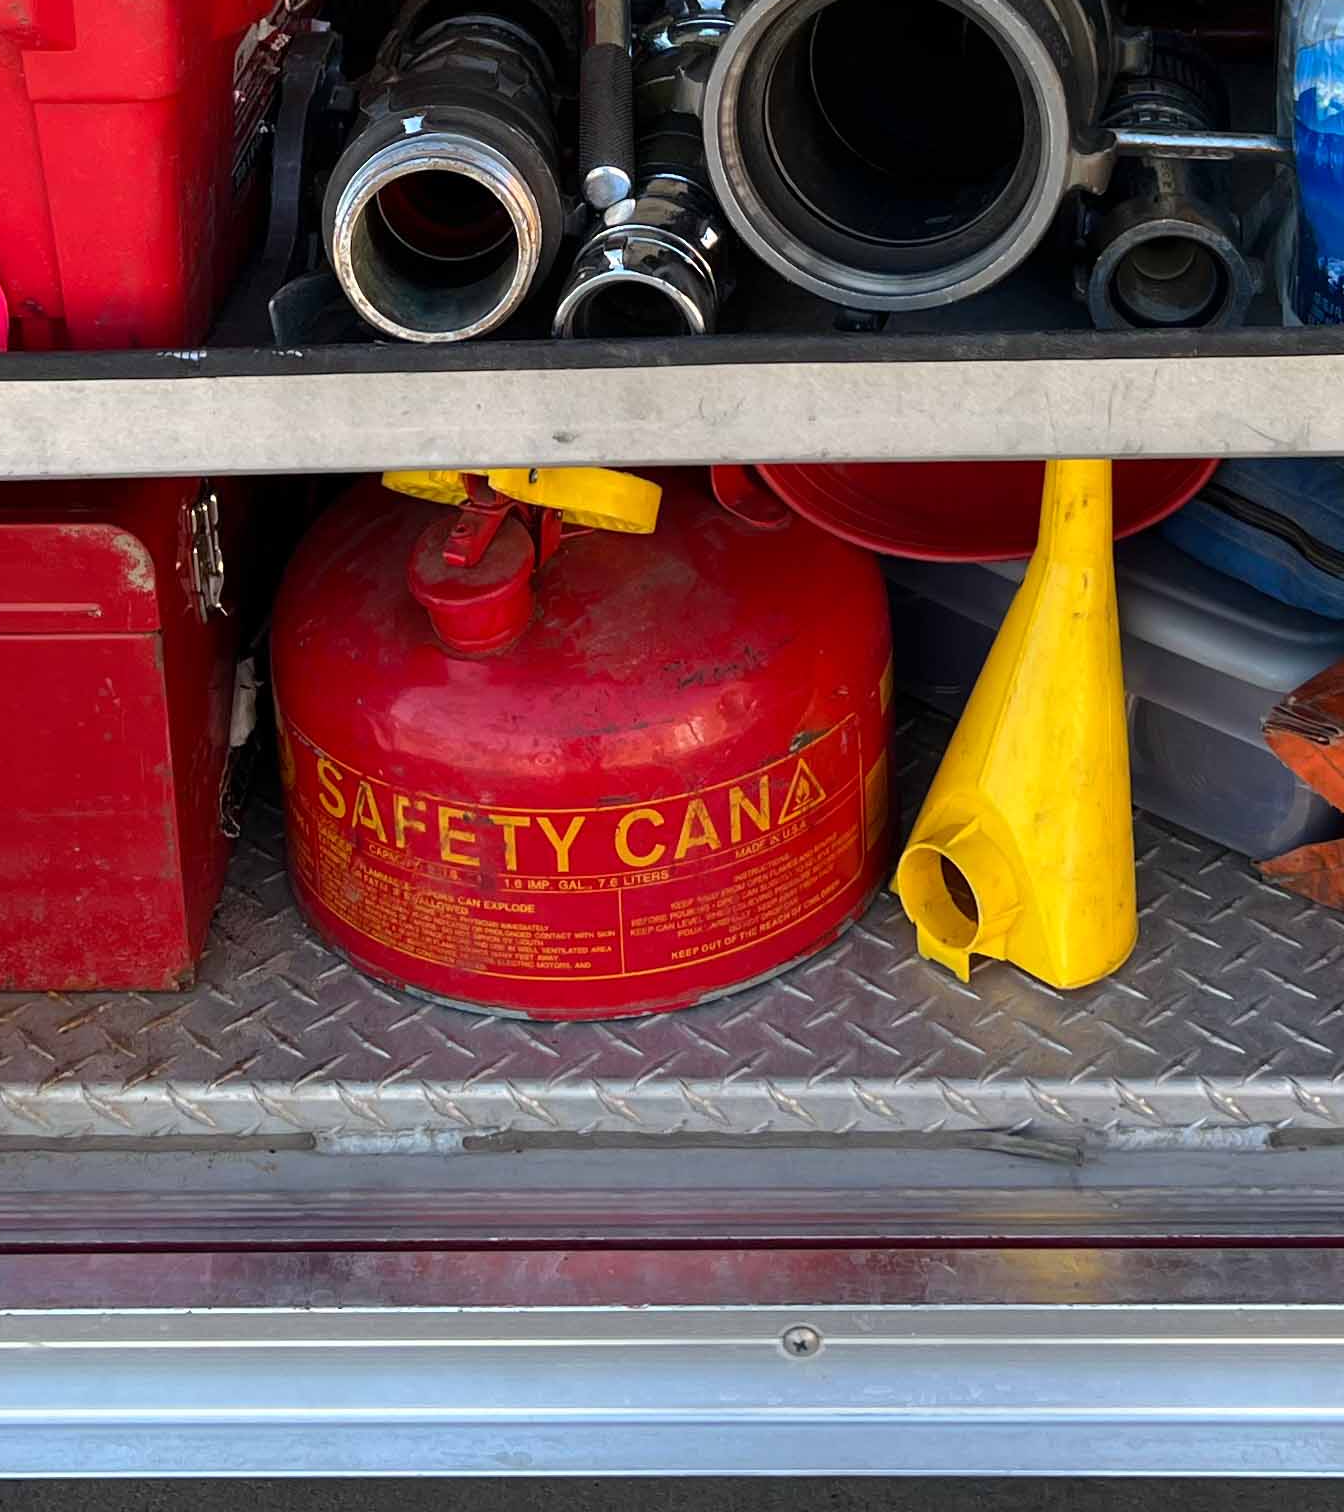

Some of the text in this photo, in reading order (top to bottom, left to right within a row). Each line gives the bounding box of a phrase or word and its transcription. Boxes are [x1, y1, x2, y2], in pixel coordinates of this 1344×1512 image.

[316, 758, 588, 874] SAFETY
[614, 774, 771, 869] CAN
[623, 869, 670, 886] LITERS
[457, 895, 481, 909] CAN
[483, 899, 536, 914] EXPLODE
[671, 946, 700, 960] KEEP
[701, 939, 722, 953] OUT
[723, 934, 737, 946] OF
